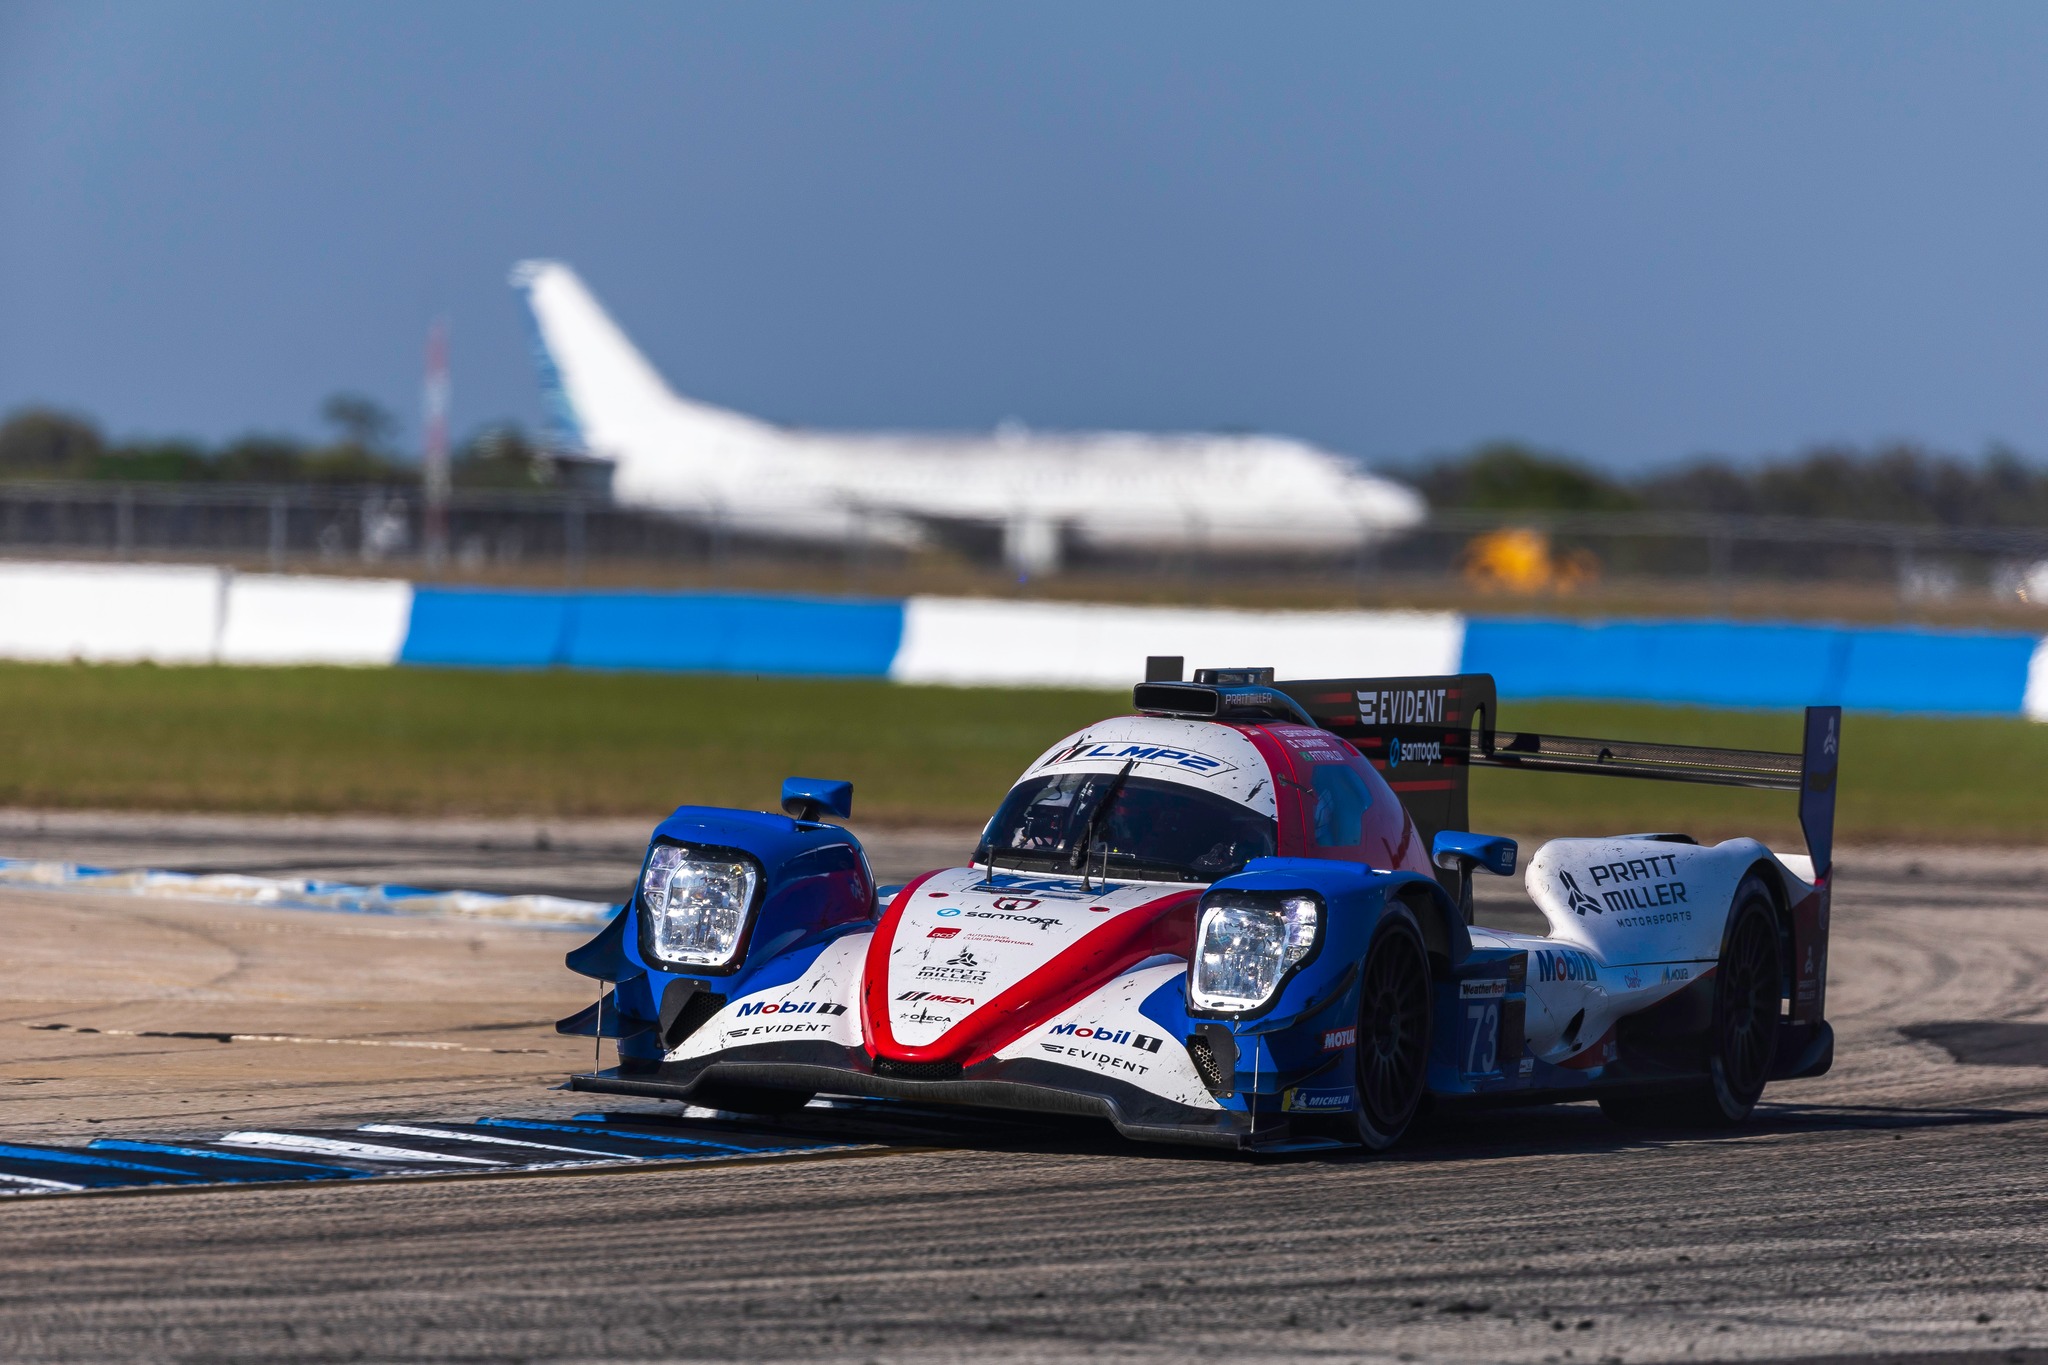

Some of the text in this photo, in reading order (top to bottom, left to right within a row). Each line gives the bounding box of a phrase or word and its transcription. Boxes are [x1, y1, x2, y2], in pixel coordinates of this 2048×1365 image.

[1379, 689, 1446, 725] EVIDENT
[1085, 745, 1220, 771] LMP2
[1401, 741, 1442, 767] santogal
[1588, 853, 1677, 887] PRATT
[1601, 881, 1688, 912] MILLER
[965, 911, 1063, 926] santogal
[1616, 910, 1692, 928] MOTORSPORTS
[921, 966, 991, 976] PRATT
[1535, 950, 1584, 982] Mobil
[915, 976, 984, 985] MOTORSPORTS
[918, 971, 987, 982] MILLER
[1462, 983, 1505, 995] WeatherTech
[736, 1001, 817, 1017] Mobil
[924, 994, 974, 1005] IMSA
[752, 1024, 831, 1035] EVIDENT
[1048, 1023, 1131, 1045] Mobil
[1324, 1029, 1355, 1049] MOTUL
[1467, 1003, 1498, 1073] 73
[1066, 1047, 1149, 1075] EVIDENT
[1308, 1094, 1351, 1106] MICHELIN
